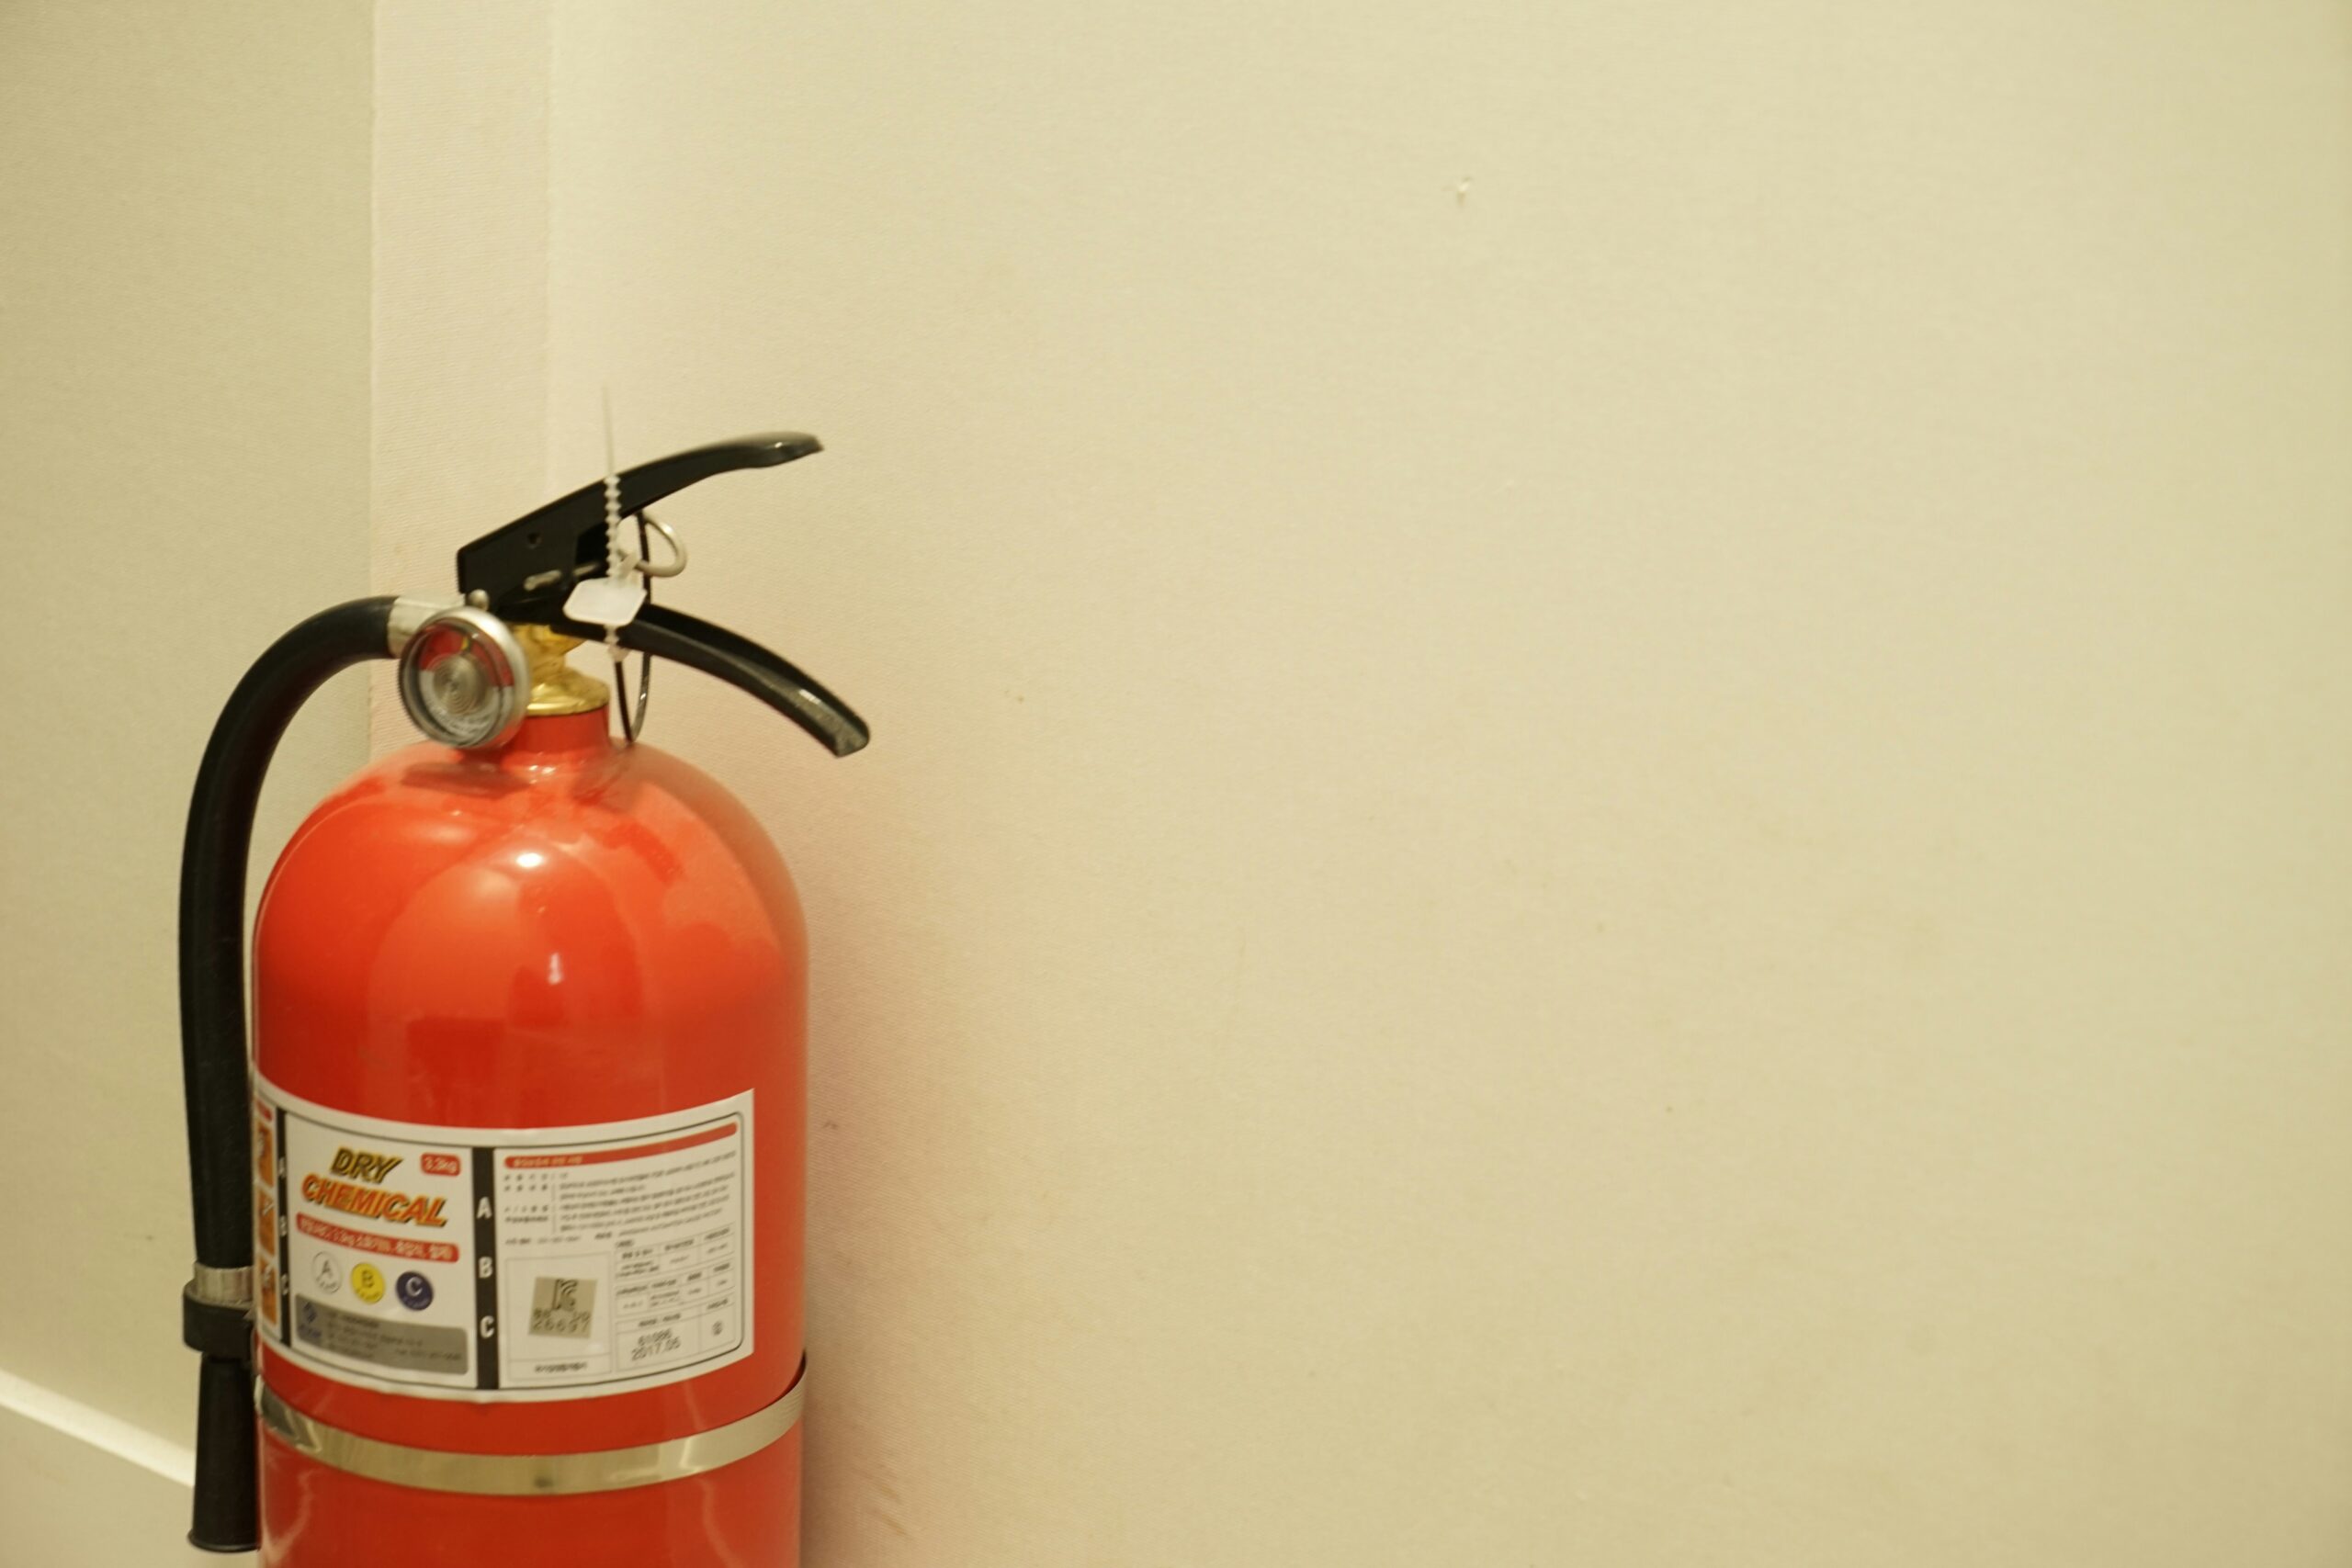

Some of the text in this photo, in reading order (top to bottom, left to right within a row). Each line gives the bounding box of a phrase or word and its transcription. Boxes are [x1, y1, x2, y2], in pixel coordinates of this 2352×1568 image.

[331, 1147, 403, 1184] DRY
[301, 1173, 447, 1227] CHEMICAL
[321, 1259, 334, 1279] A
[361, 1269, 375, 1289] B
[476, 1196, 494, 1339] A B C
[405, 1276, 423, 1297] C
